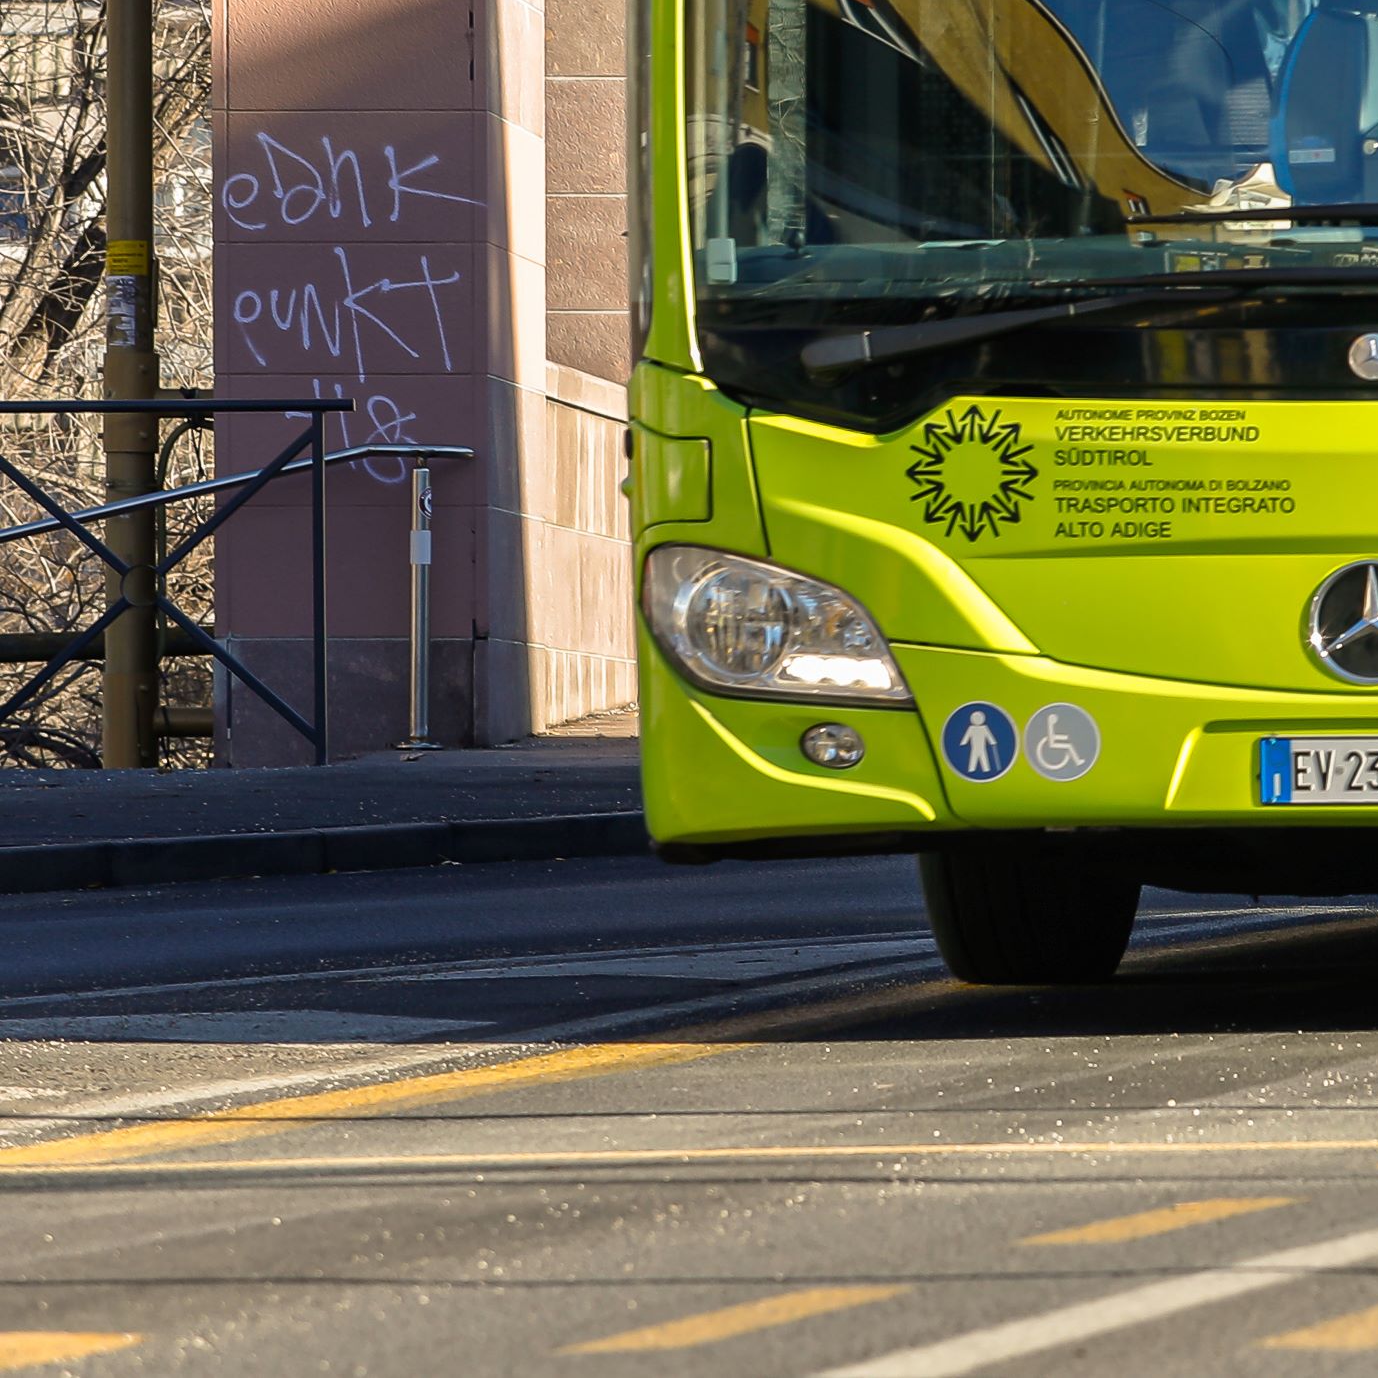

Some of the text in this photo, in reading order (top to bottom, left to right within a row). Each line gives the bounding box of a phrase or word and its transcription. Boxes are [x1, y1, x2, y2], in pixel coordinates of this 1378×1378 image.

[1055, 409, 1246, 421] AUTONOME PROVINZ BOZEN
[1054, 425, 1260, 442] VERKEHRSVERBUND
[1054, 447, 1153, 466] SÜDTIROL
[1053, 479, 1291, 491] PROVINCIA AUTONOMA DI BOLZANO
[1054, 497, 1296, 513] TRASPORTO INTEGRATO
[1054, 521, 1172, 538] ALTO ADIGE
